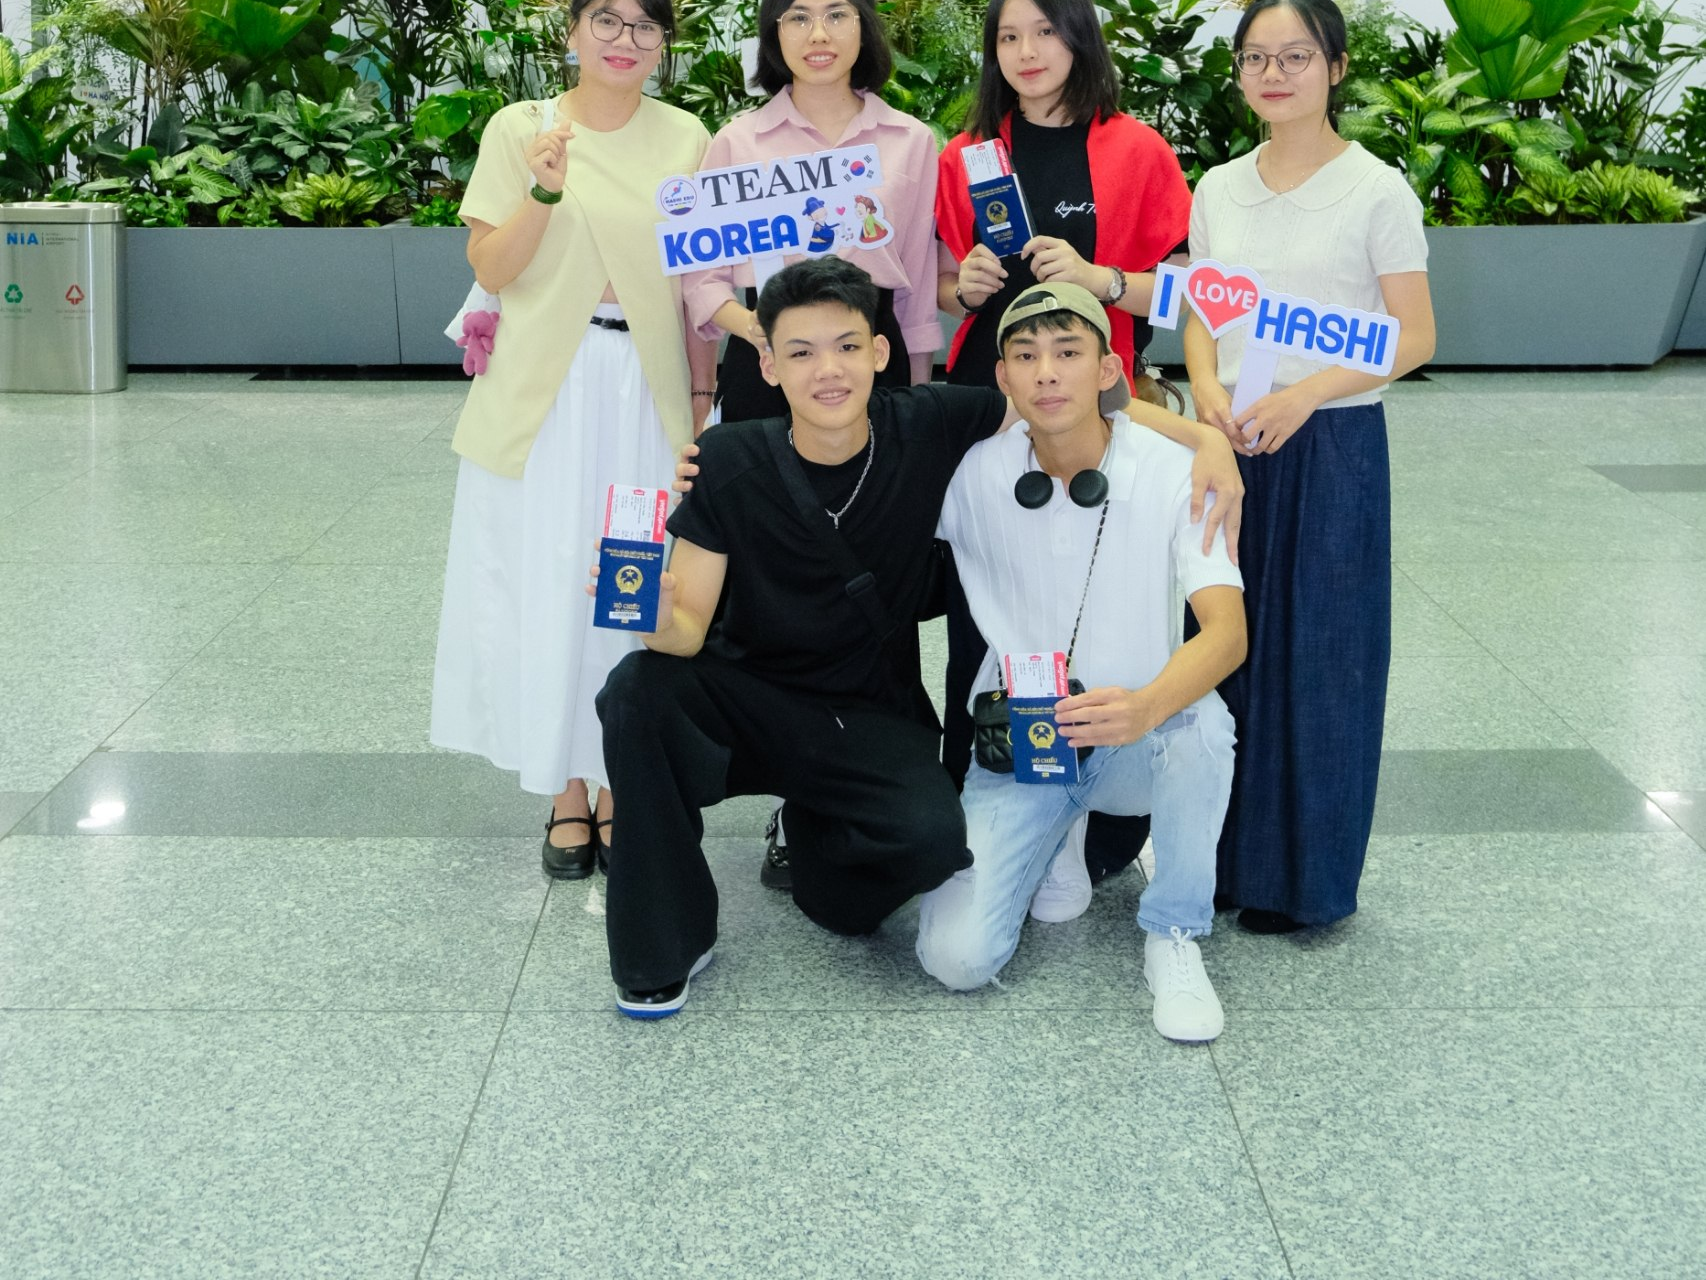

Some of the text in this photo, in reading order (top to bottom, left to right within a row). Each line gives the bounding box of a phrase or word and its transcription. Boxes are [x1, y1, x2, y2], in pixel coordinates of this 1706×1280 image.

[702, 155, 837, 207] TEAM
[6, 232, 39, 246] NIA
[664, 214, 800, 268] KOREA
[1158, 273, 1389, 366] I LOVE HASHI
